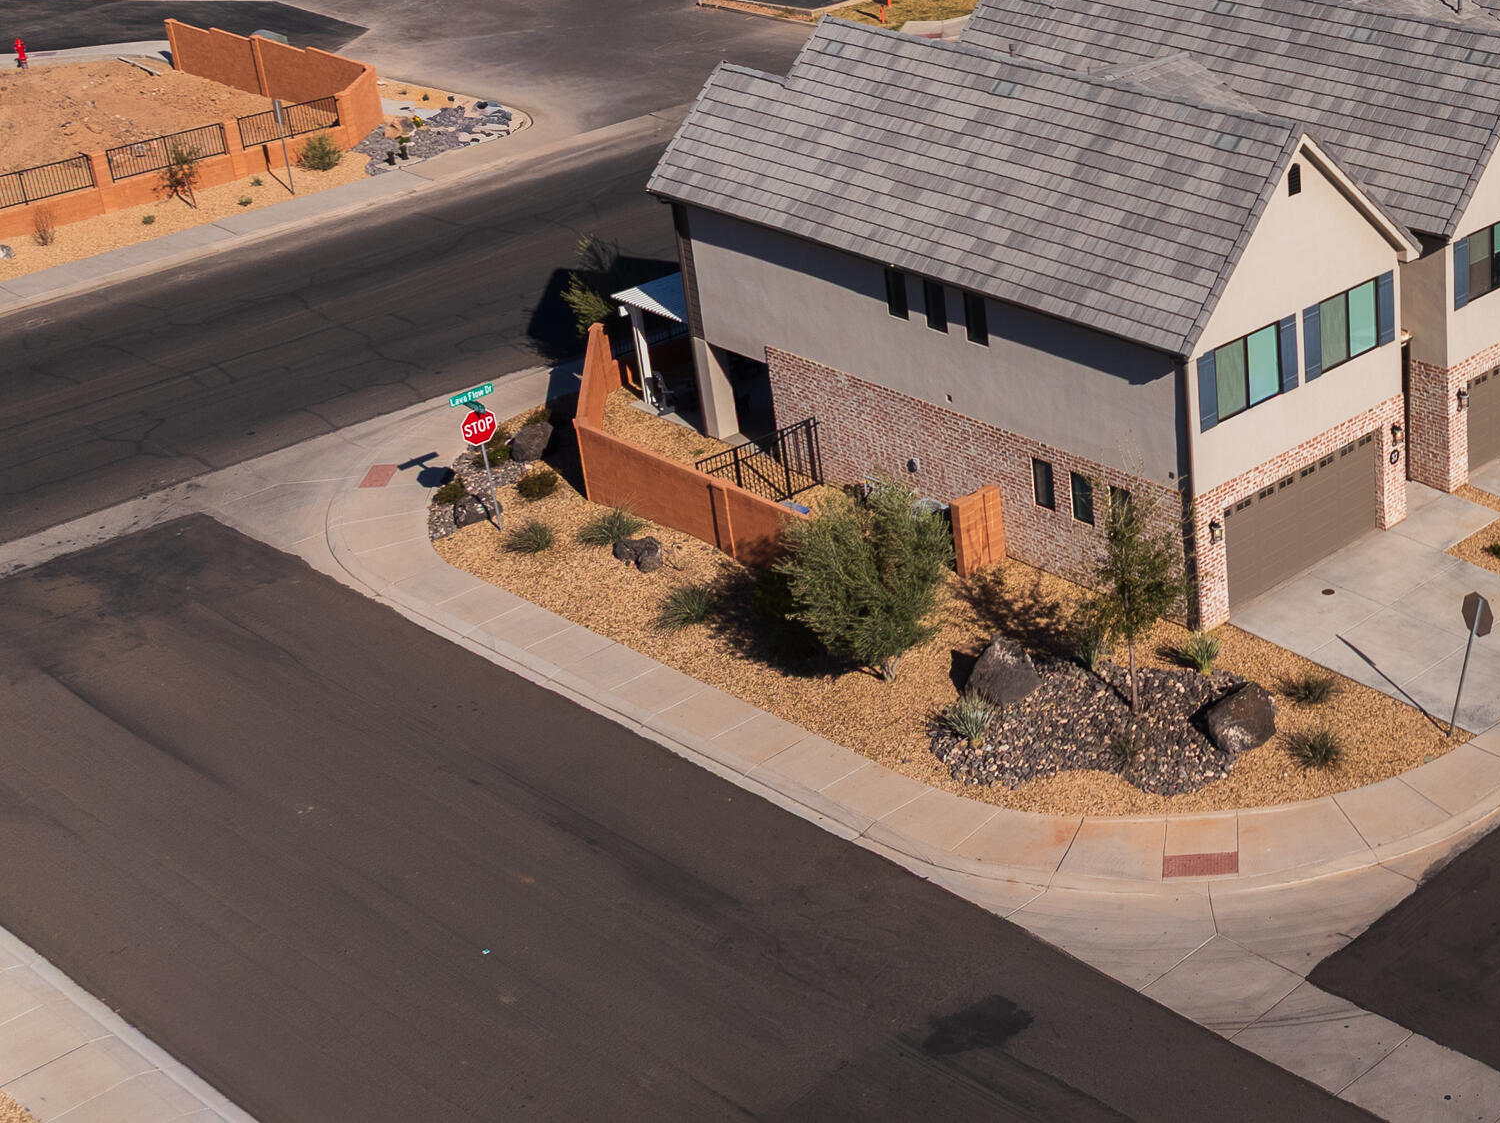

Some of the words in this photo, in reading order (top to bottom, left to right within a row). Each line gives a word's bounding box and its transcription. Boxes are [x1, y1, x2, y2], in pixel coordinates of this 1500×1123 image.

[450, 395, 468, 407] Lava
[468, 390, 484, 401] Flow
[484, 385, 492, 394] Dr
[464, 416, 493, 438] STOP
